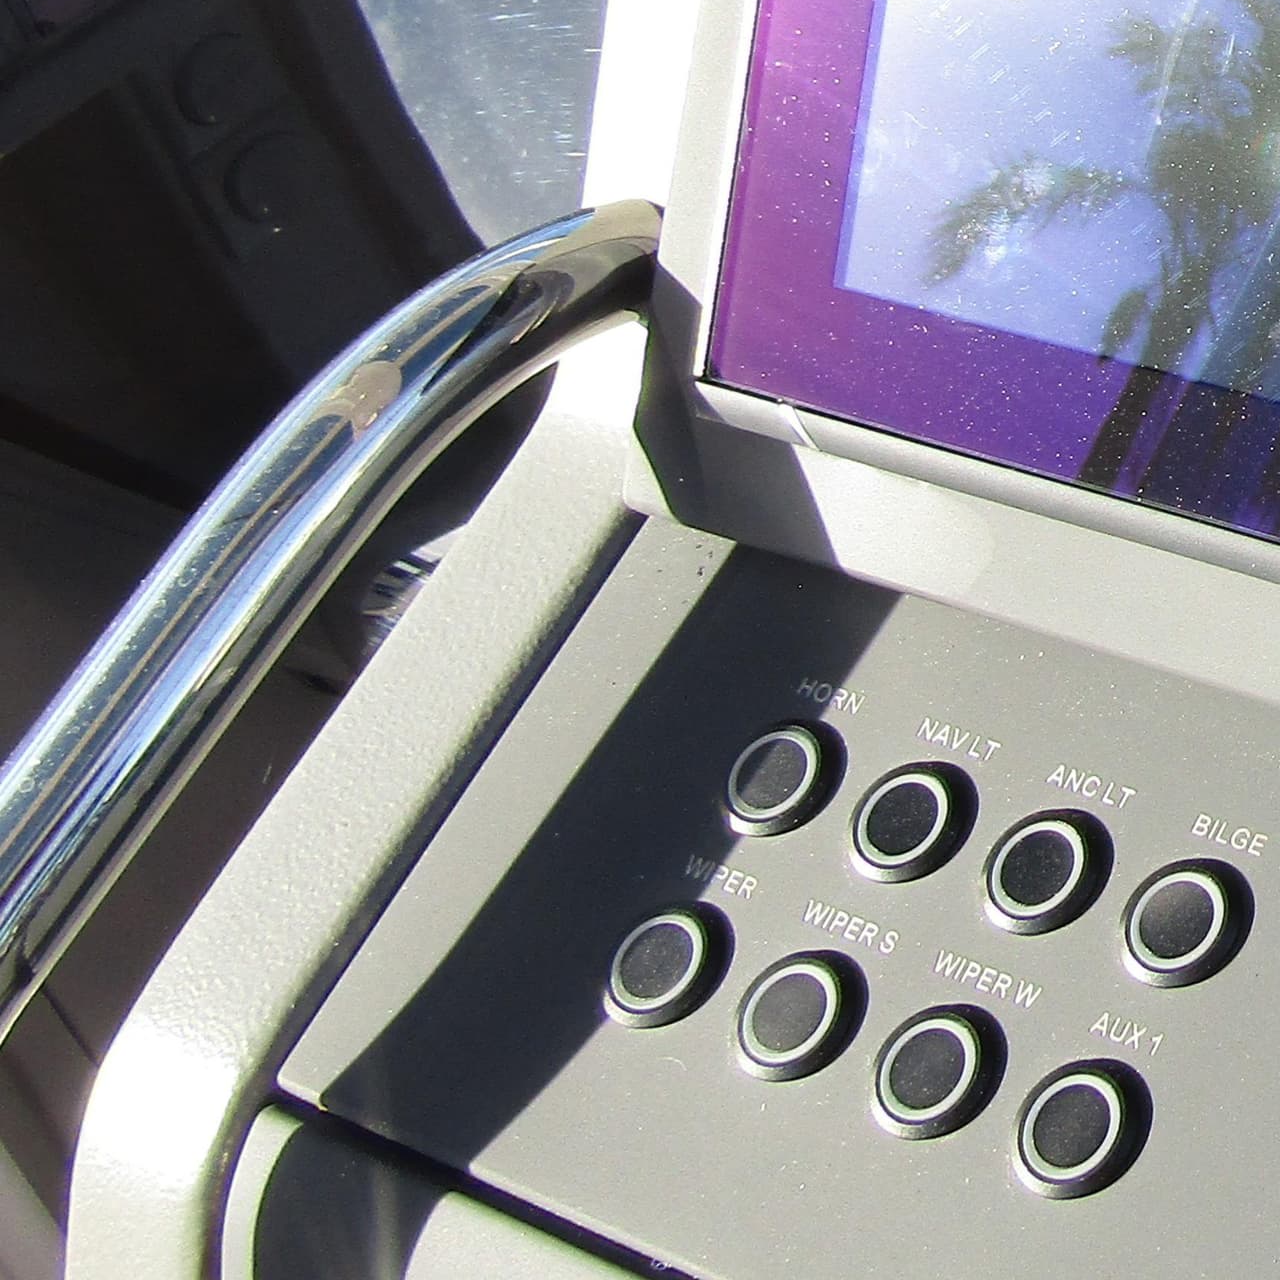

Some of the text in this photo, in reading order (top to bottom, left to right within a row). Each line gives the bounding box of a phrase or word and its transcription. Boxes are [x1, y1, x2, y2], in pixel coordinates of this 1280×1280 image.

[797, 677, 865, 714] HORN
[917, 717, 1001, 761] NAV LT
[1046, 764, 1137, 809] ANC LT
[1191, 814, 1268, 856] BILGE
[685, 854, 757, 899] WIPER
[802, 899, 899, 954] WIPER S
[934, 949, 1042, 1008] WIPER W
[1089, 1012, 1164, 1056] AUX 1
